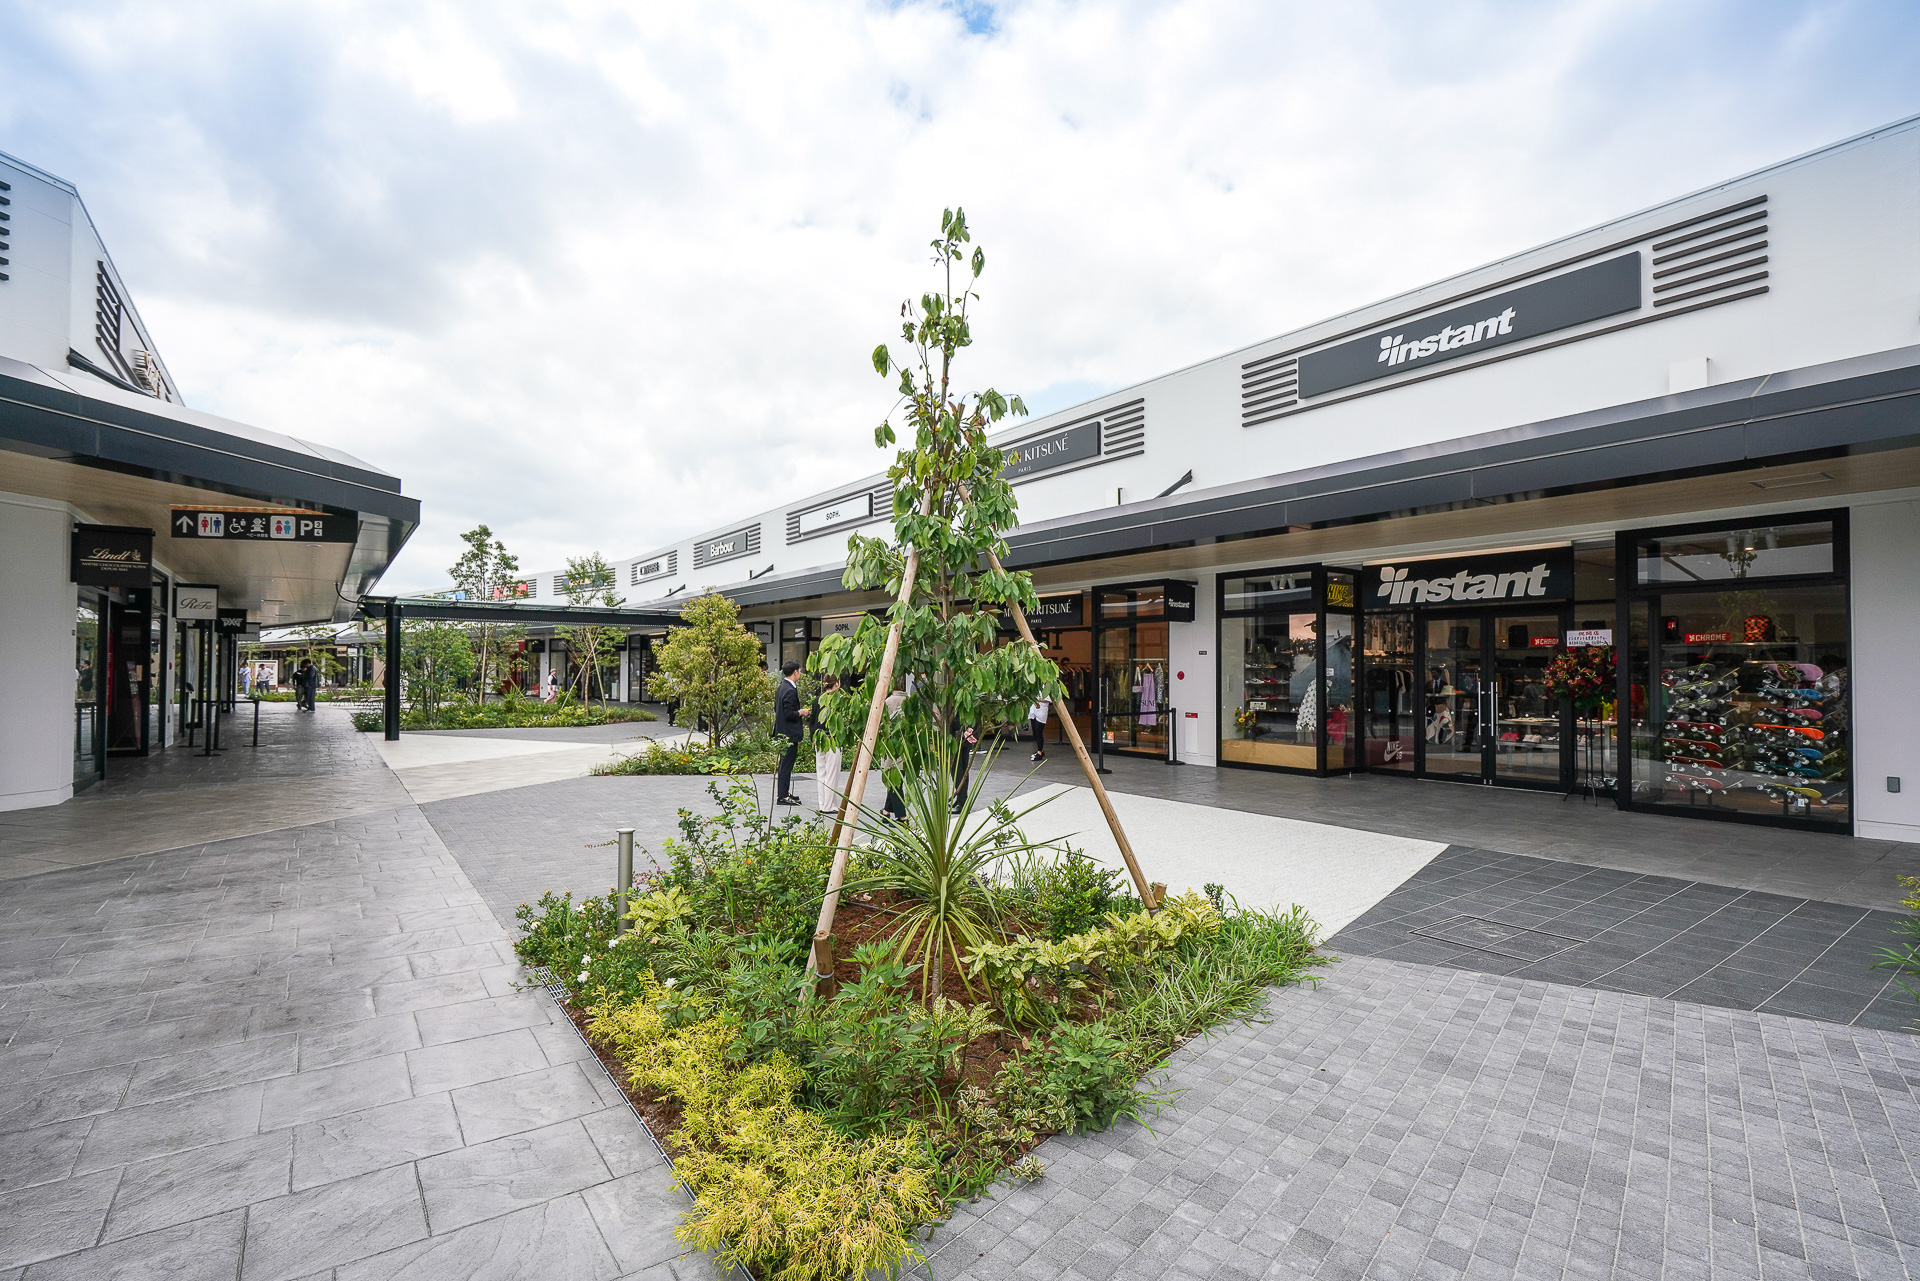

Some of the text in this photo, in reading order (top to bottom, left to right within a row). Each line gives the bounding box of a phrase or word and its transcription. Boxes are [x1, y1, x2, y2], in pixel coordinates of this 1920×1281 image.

[1378, 306, 1516, 366] instant
[1024, 433, 1069, 462] KITSUNÉ
[300, 520, 313, 536] P
[88, 548, 131, 560] Lindt
[711, 541, 735, 557] Barbour
[1377, 563, 1550, 604] instant
[1327, 584, 1349, 599] NIKE
[180, 598, 215, 609] ReFa
[1036, 599, 1072, 615] KITSUNÉ
[1169, 598, 1190, 608] instant
[1695, 633, 1727, 641] CHROME
[1387, 741, 1400, 751] NIKE
[1396, 752, 1403, 760] SB
